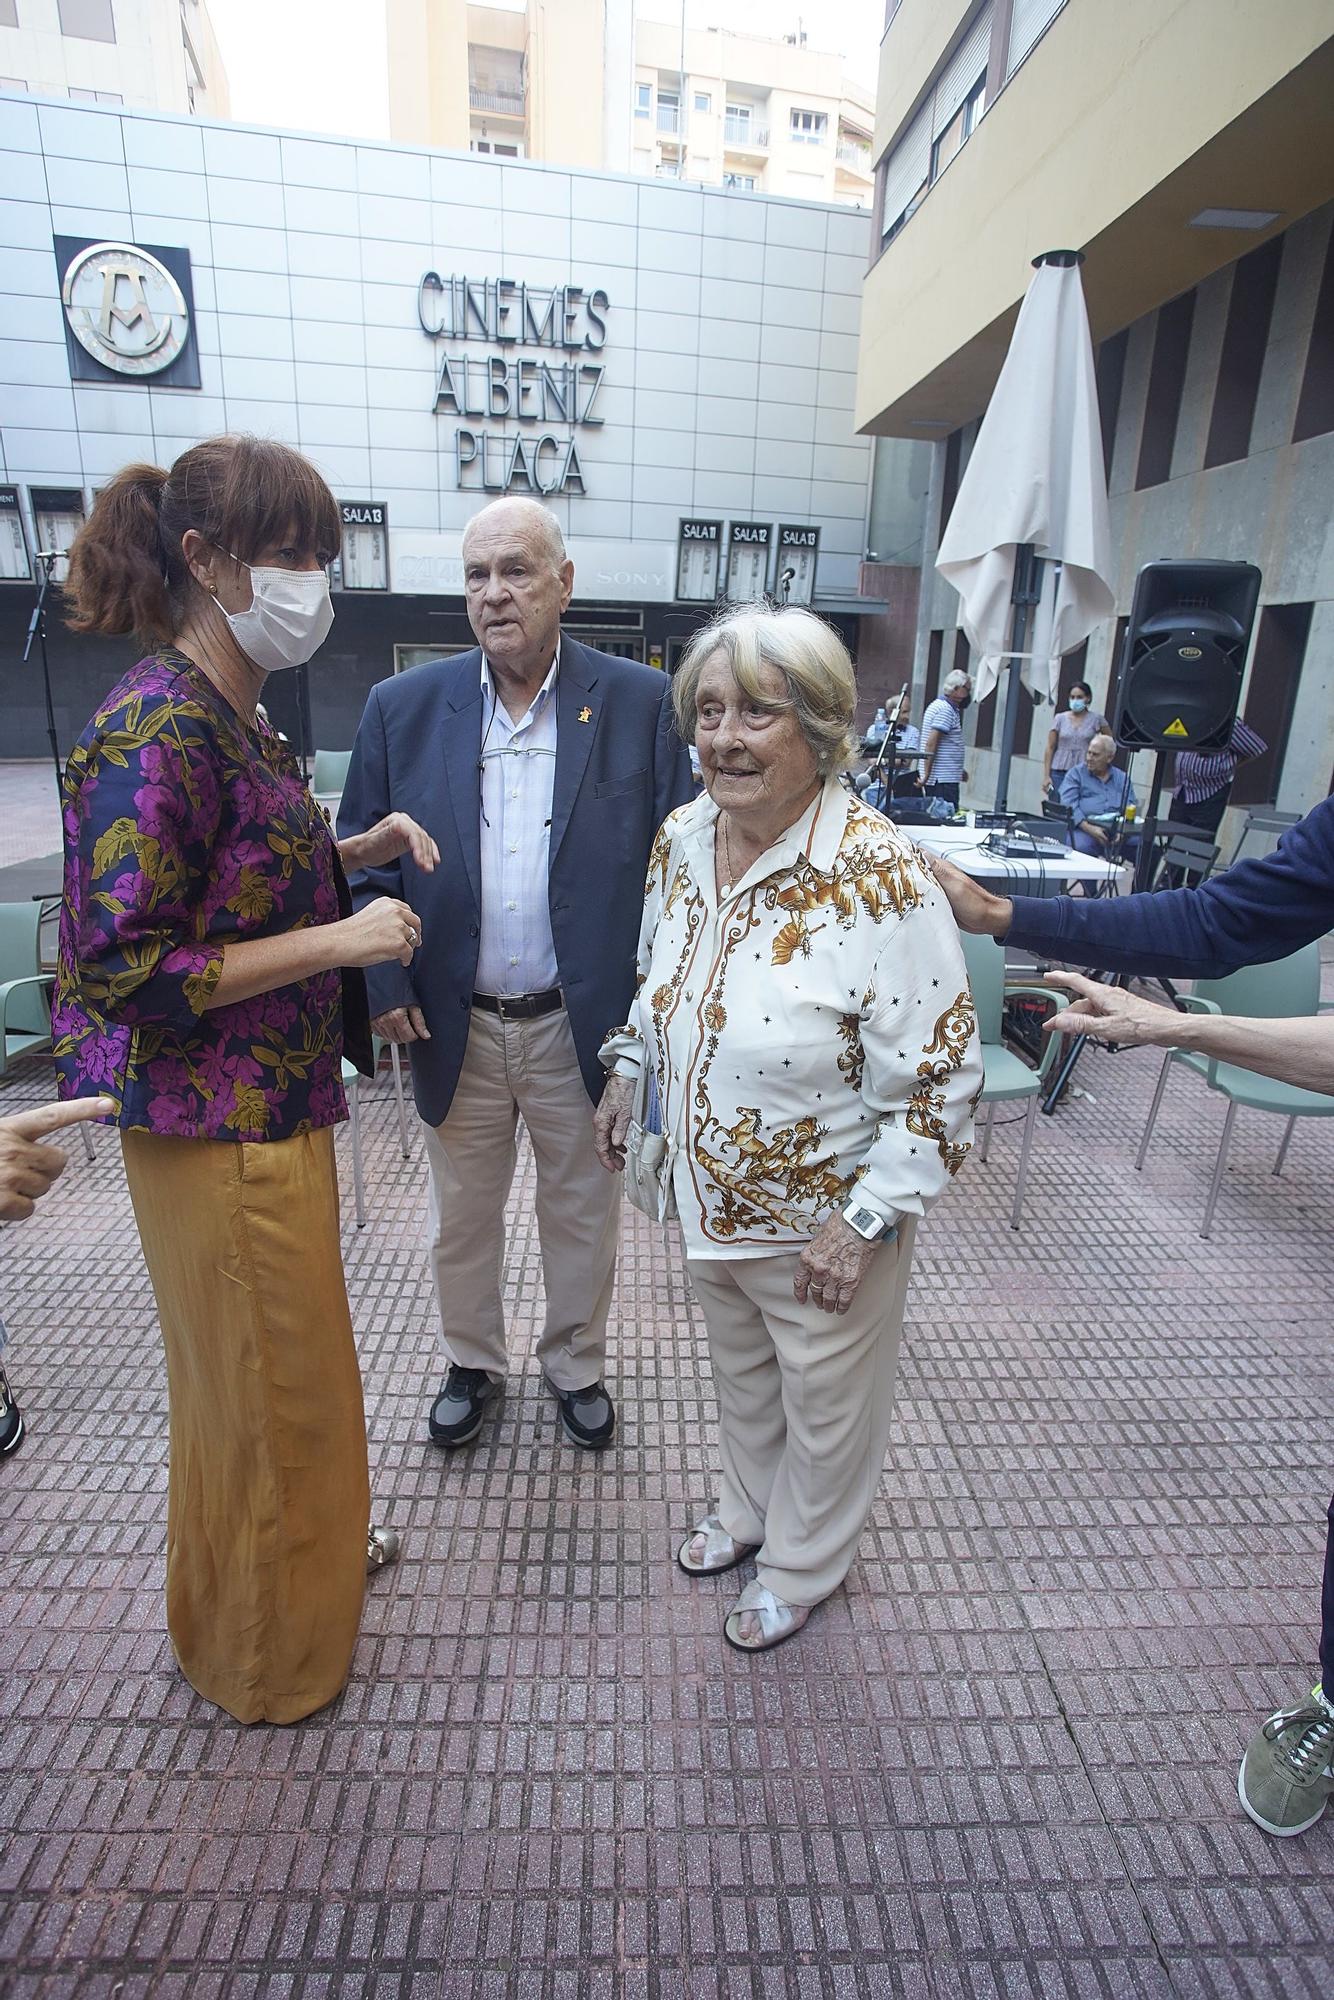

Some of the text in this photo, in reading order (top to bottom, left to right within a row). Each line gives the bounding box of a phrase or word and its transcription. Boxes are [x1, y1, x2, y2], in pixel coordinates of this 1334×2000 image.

[418, 271, 610, 350] CINEMES
[432, 351, 606, 426] ALBENIZ
[456, 428, 586, 495] PLAÇA
[343, 507, 382, 524] SALA 13
[683, 524, 717, 539] SALA 11
[734, 527, 767, 543] SALA 12
[783, 531, 816, 546] SALA 13
[596, 570, 665, 586] SONY
